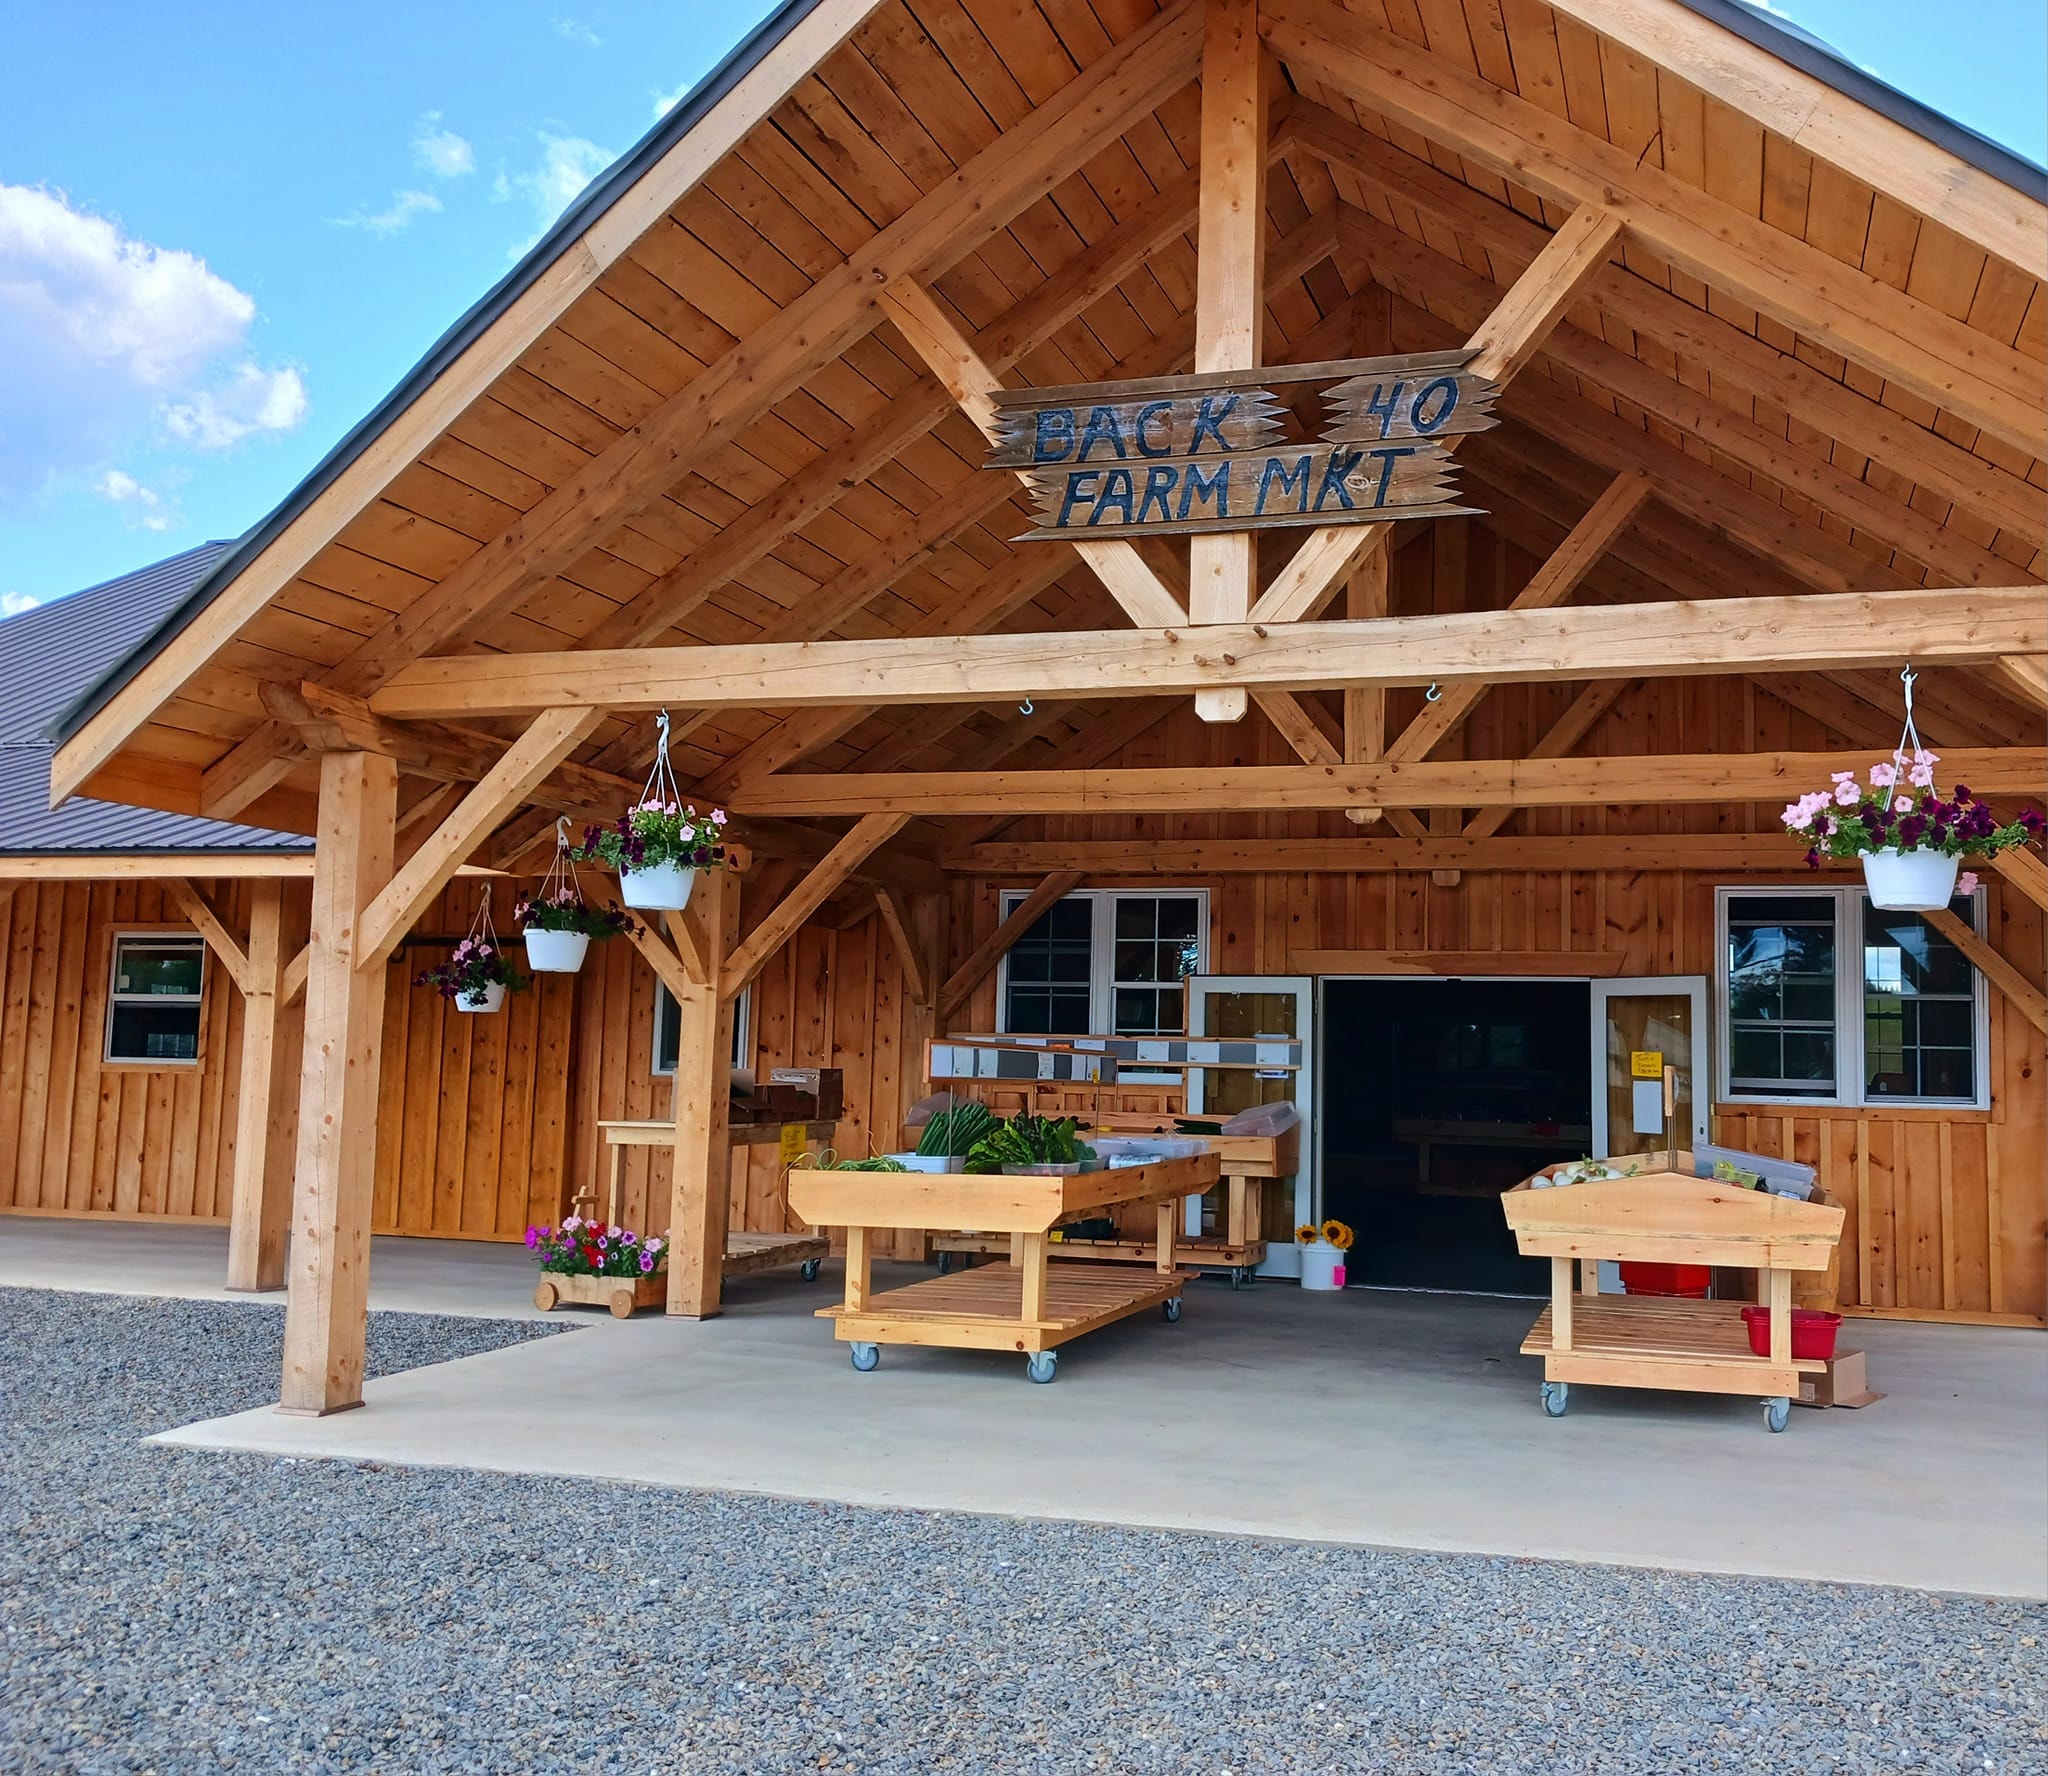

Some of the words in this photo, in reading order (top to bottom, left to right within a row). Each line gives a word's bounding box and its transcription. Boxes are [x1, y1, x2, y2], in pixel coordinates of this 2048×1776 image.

[1032, 395, 1240, 464] BACK
[1366, 376, 1460, 439] 40
[1056, 460, 1232, 528] FARM
[1254, 446, 1416, 517] MKT
